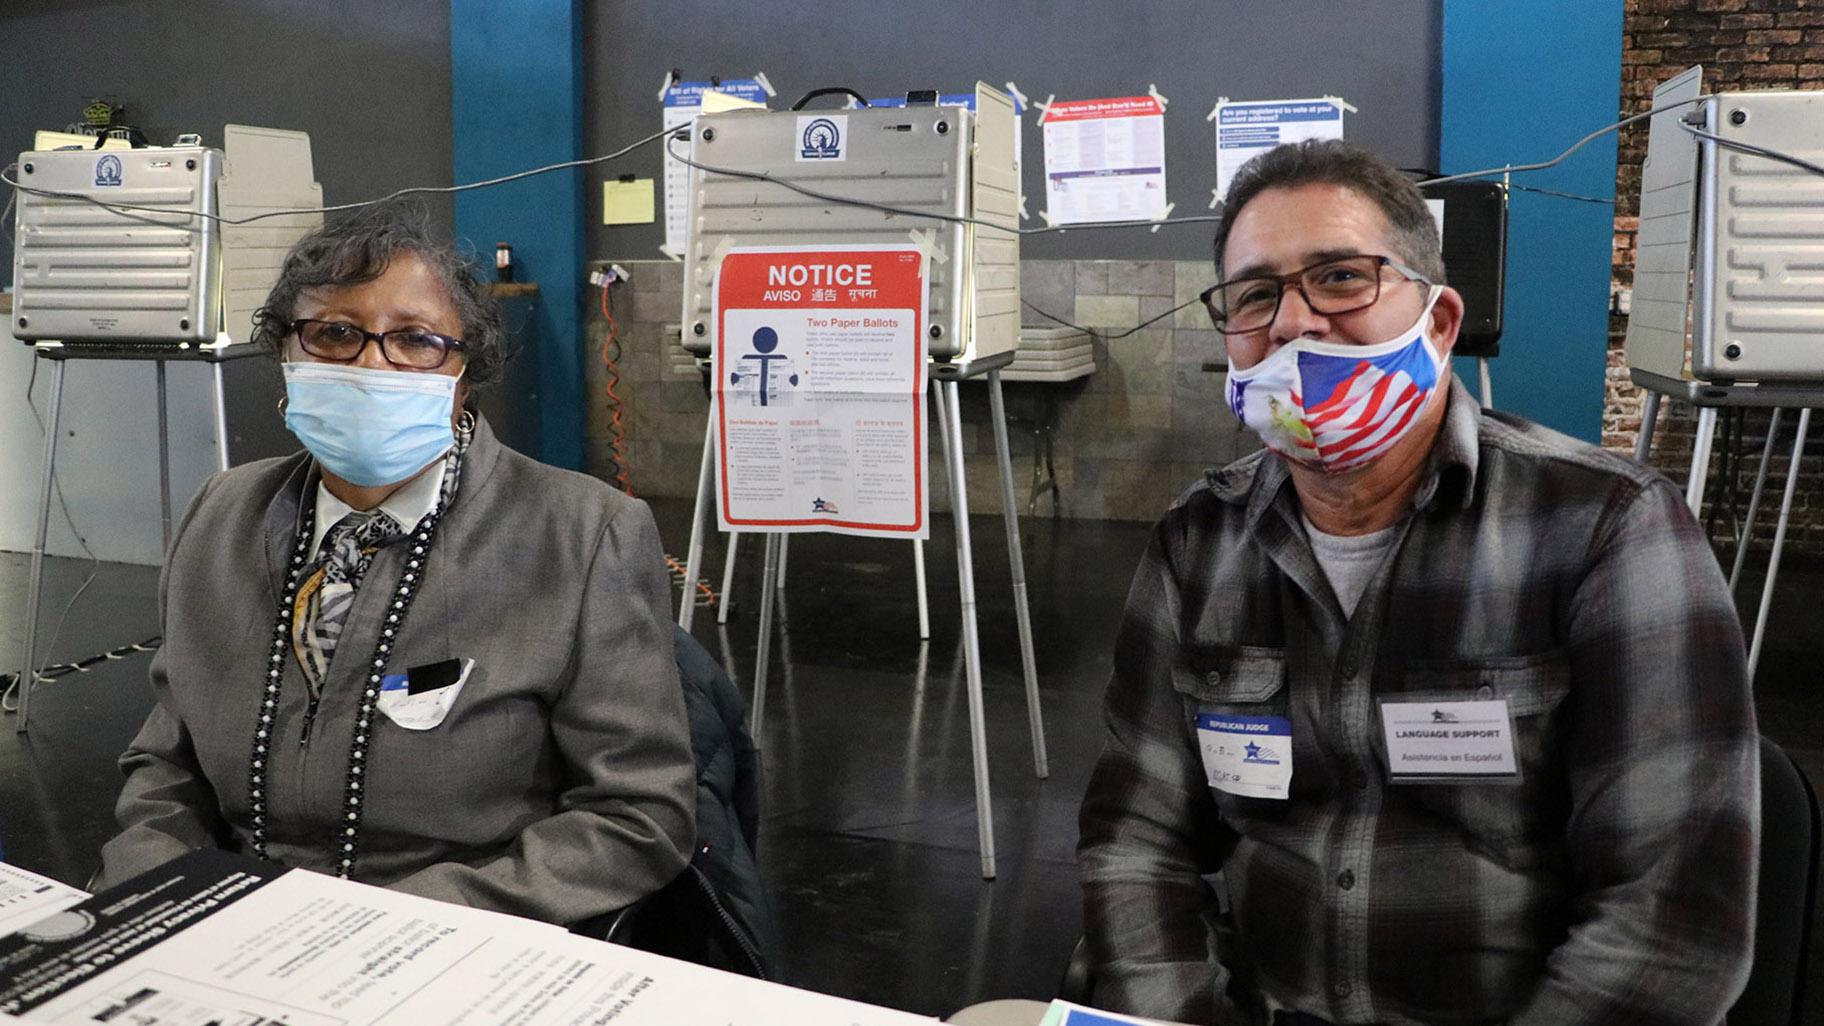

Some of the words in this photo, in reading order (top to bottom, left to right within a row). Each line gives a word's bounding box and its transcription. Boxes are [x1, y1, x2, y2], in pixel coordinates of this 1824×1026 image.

[1222, 109, 1234, 117] Are
[1249, 107, 1283, 117] registered
[1317, 106, 1333, 114] your
[768, 263, 872, 286] NOTICE
[763, 289, 801, 302] AVISO
[811, 288, 837, 302] 通告
[848, 288, 878, 302] सूचना
[807, 318, 828, 327] Two
[831, 318, 860, 329] Paper
[863, 318, 898, 328] Ballots
[1209, 720, 1245, 730] REPUBLICAN
[1245, 723, 1269, 731] JUDGE
[1396, 730, 1449, 738] LANGUAGE
[1452, 730, 1500, 738] SUPPORT
[1402, 753, 1448, 761] Asistencia
[1464, 753, 1502, 762] Español
[439, 927, 458, 936] To
[403, 936, 440, 960] record
[357, 946, 404, 976] straight
[371, 961, 405, 979] vote,
[628, 975, 655, 998] After
[594, 998, 633, 1026] Voting
